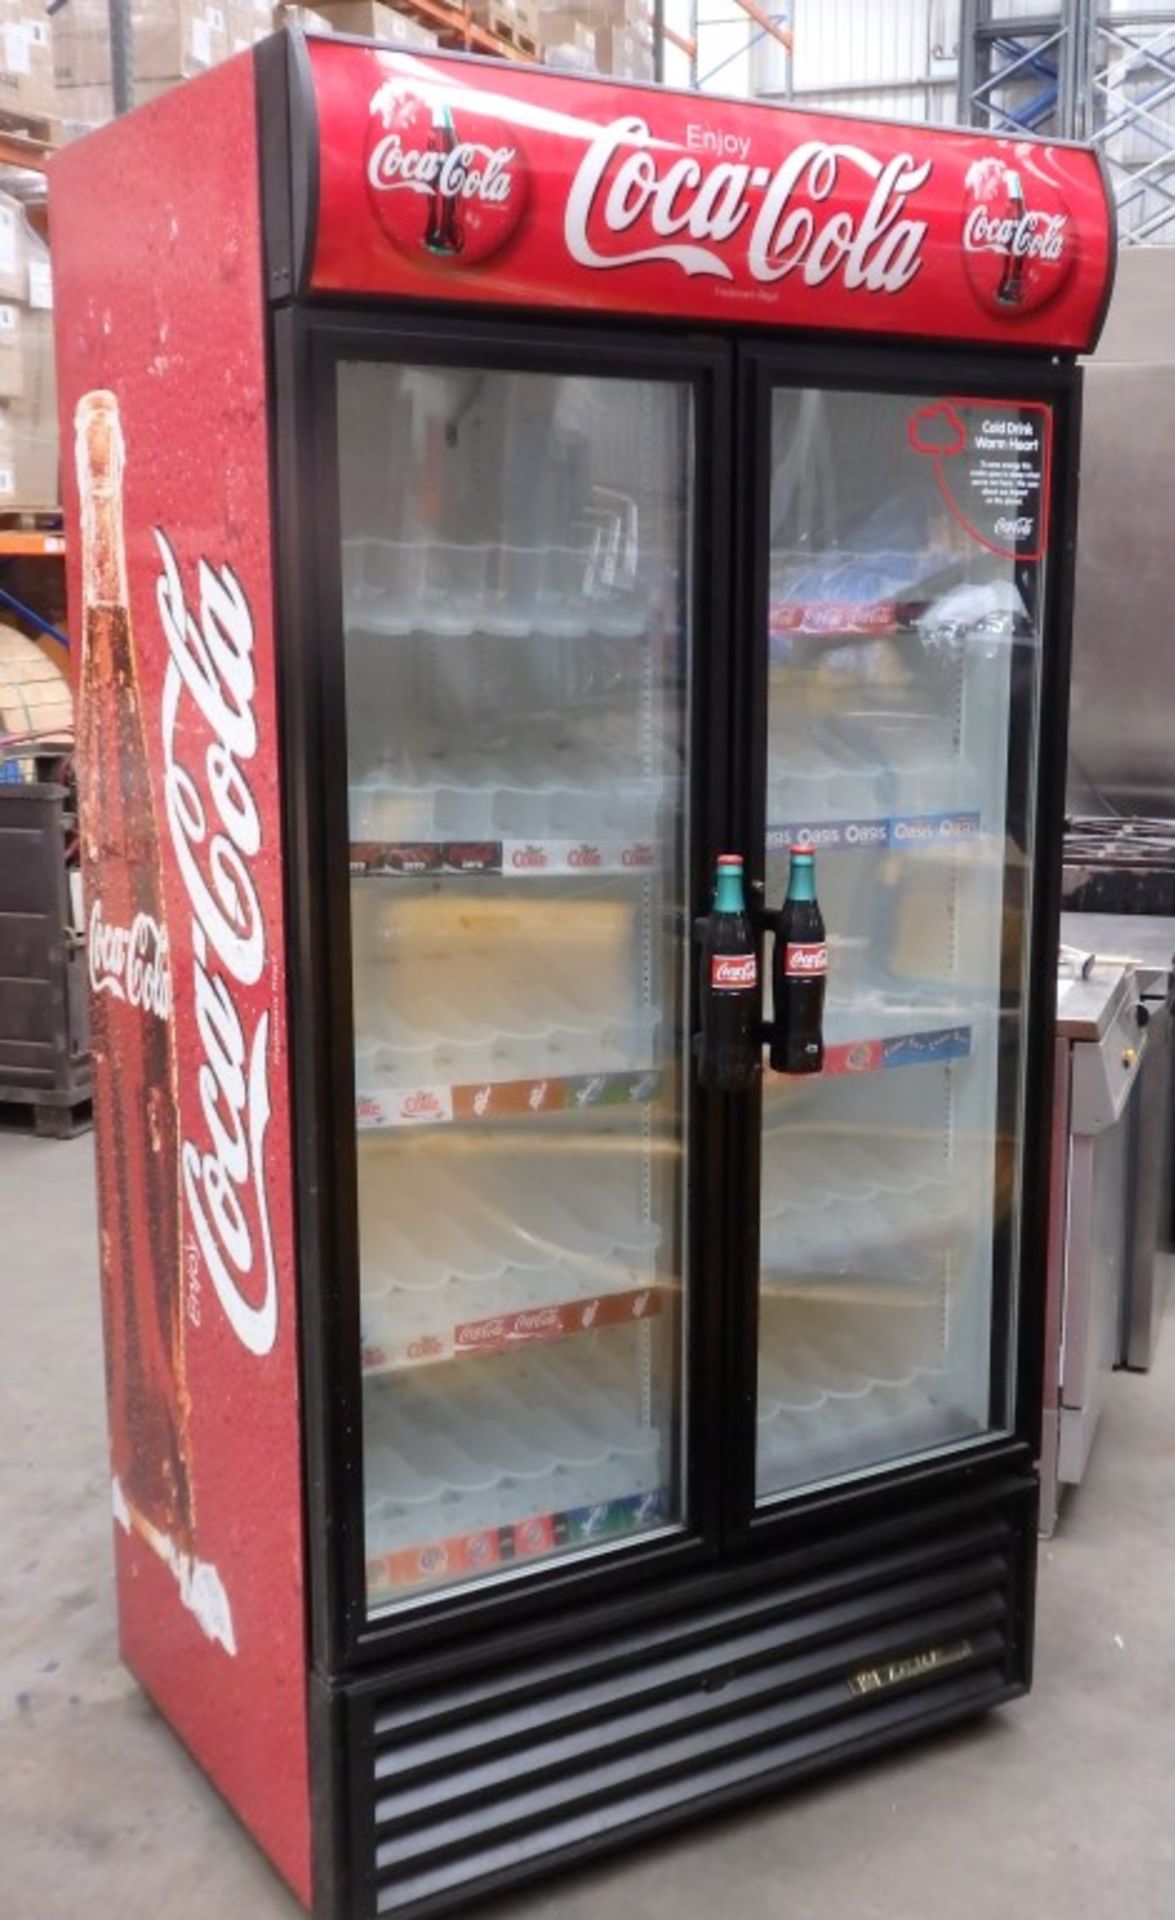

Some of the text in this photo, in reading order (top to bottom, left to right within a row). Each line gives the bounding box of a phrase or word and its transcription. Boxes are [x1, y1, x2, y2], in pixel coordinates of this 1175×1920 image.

[367, 134, 516, 201] Coca-Cola
[685, 124, 751, 160] Enjoy
[564, 116, 931, 293] Coca-Cola
[963, 204, 1067, 260] Coca-Cola
[982, 420, 1034, 436] Cold Drink
[90, 899, 170, 1021] Coca-Cola
[153, 524, 277, 1356] Coca-Cola
